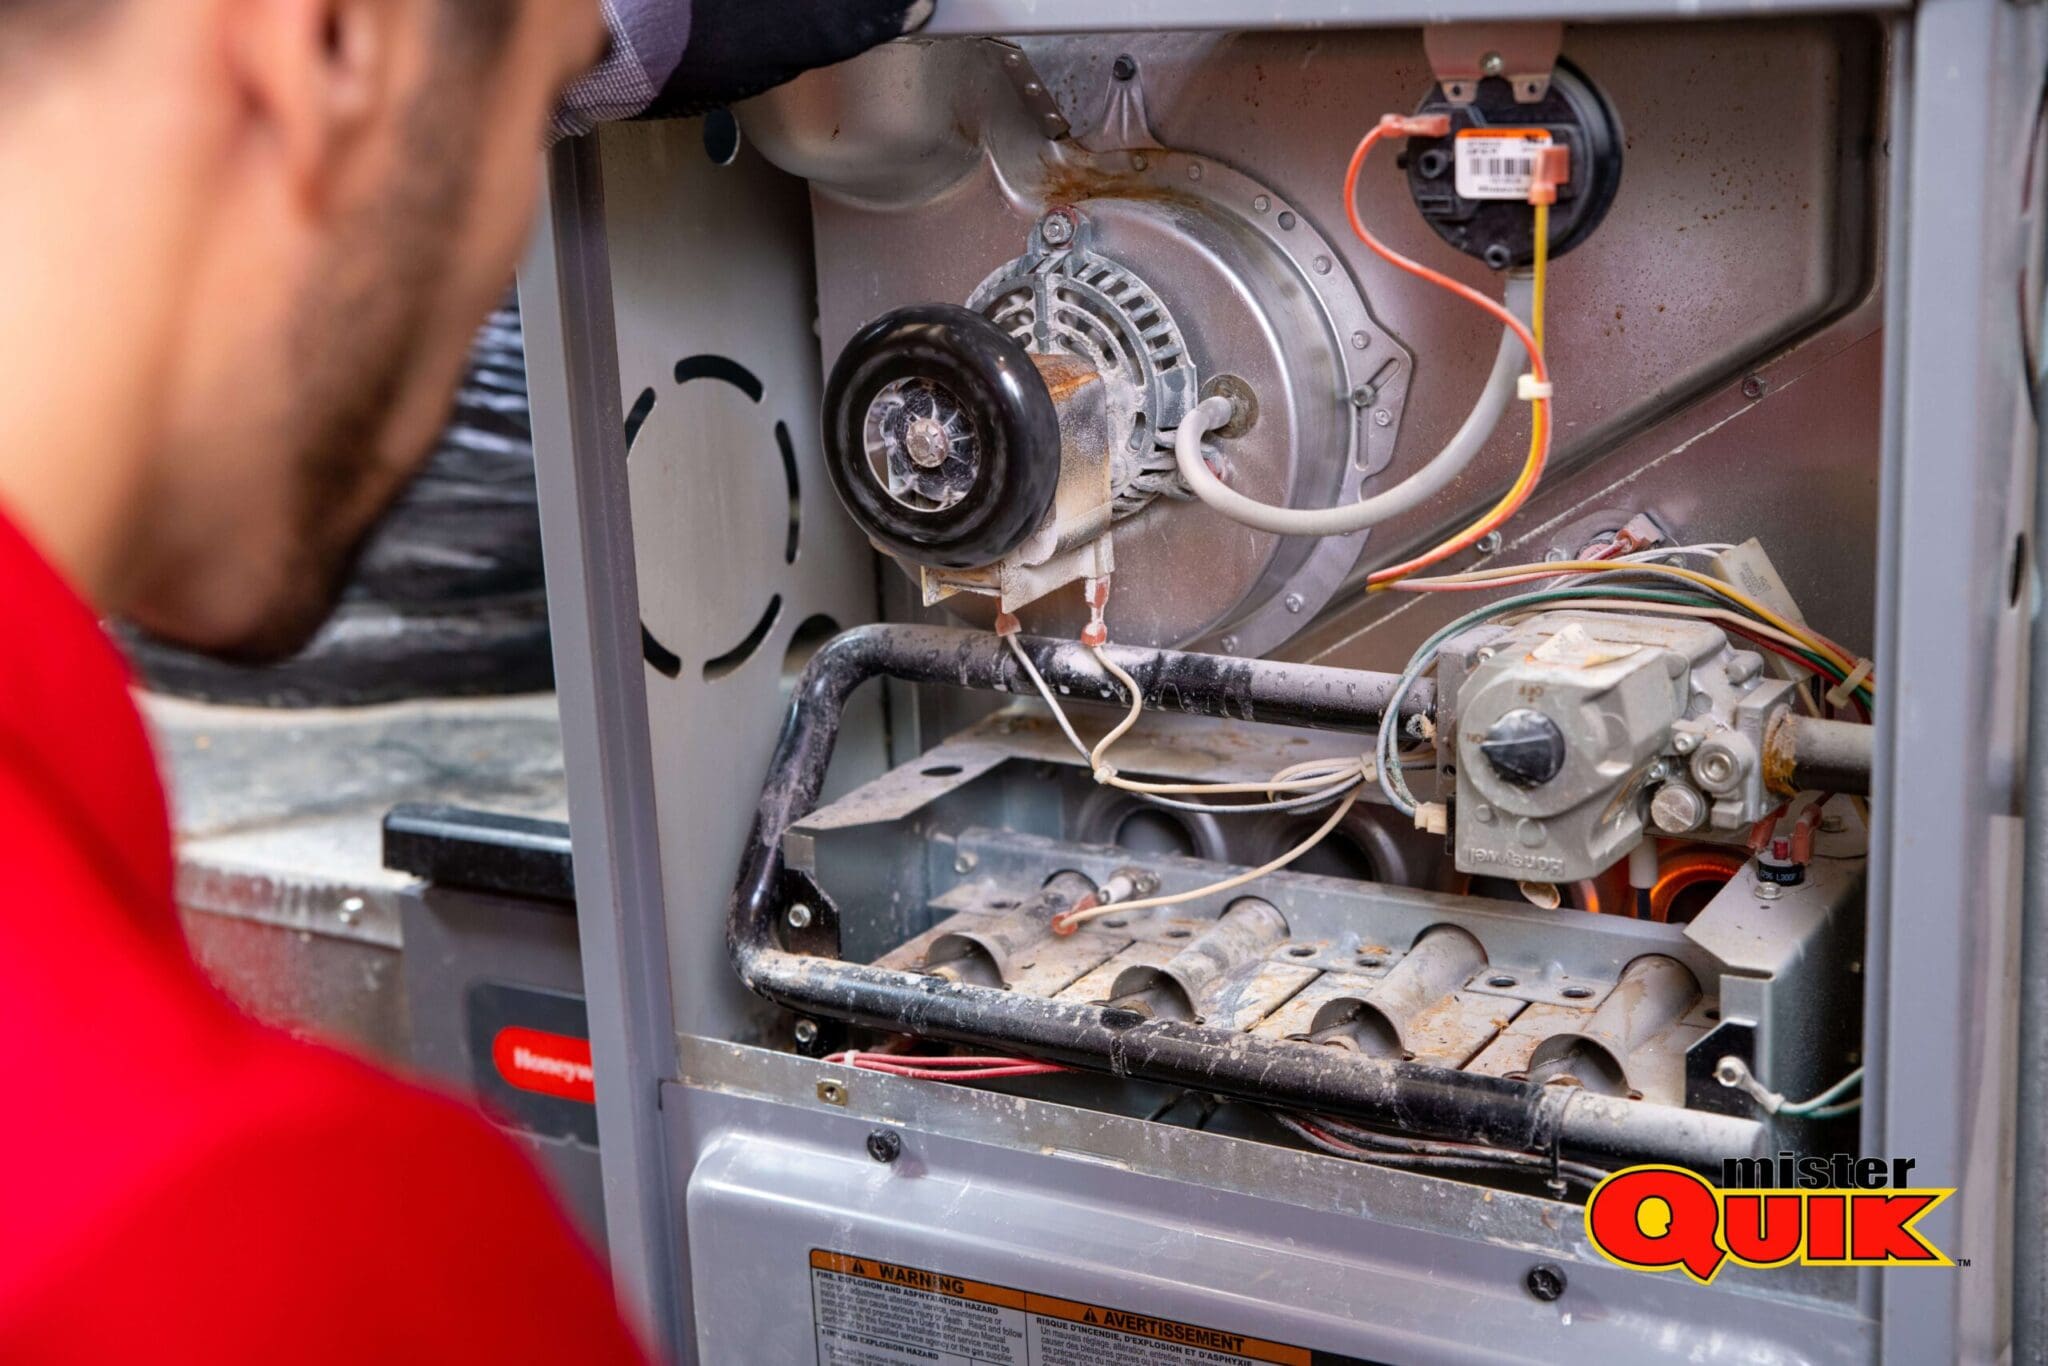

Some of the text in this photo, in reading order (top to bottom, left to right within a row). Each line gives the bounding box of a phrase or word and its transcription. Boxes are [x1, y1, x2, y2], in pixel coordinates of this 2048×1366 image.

[1464, 847, 1566, 876] Honeywell
[513, 1046, 594, 1083] Honeyw
[879, 1264, 964, 1294] WARNING
[884, 1285, 901, 1294] AND
[965, 1302, 998, 1315] HAZARD
[1036, 1316, 1253, 1366] RISQUE D'INCENDIE, D'EXPLOSION ET D'ASPHYXIE
[1103, 1309, 1244, 1353] AVERTISSEMENT
[859, 1336, 904, 1352] EXPLOSION
[906, 1347, 939, 1360] HAZARD
